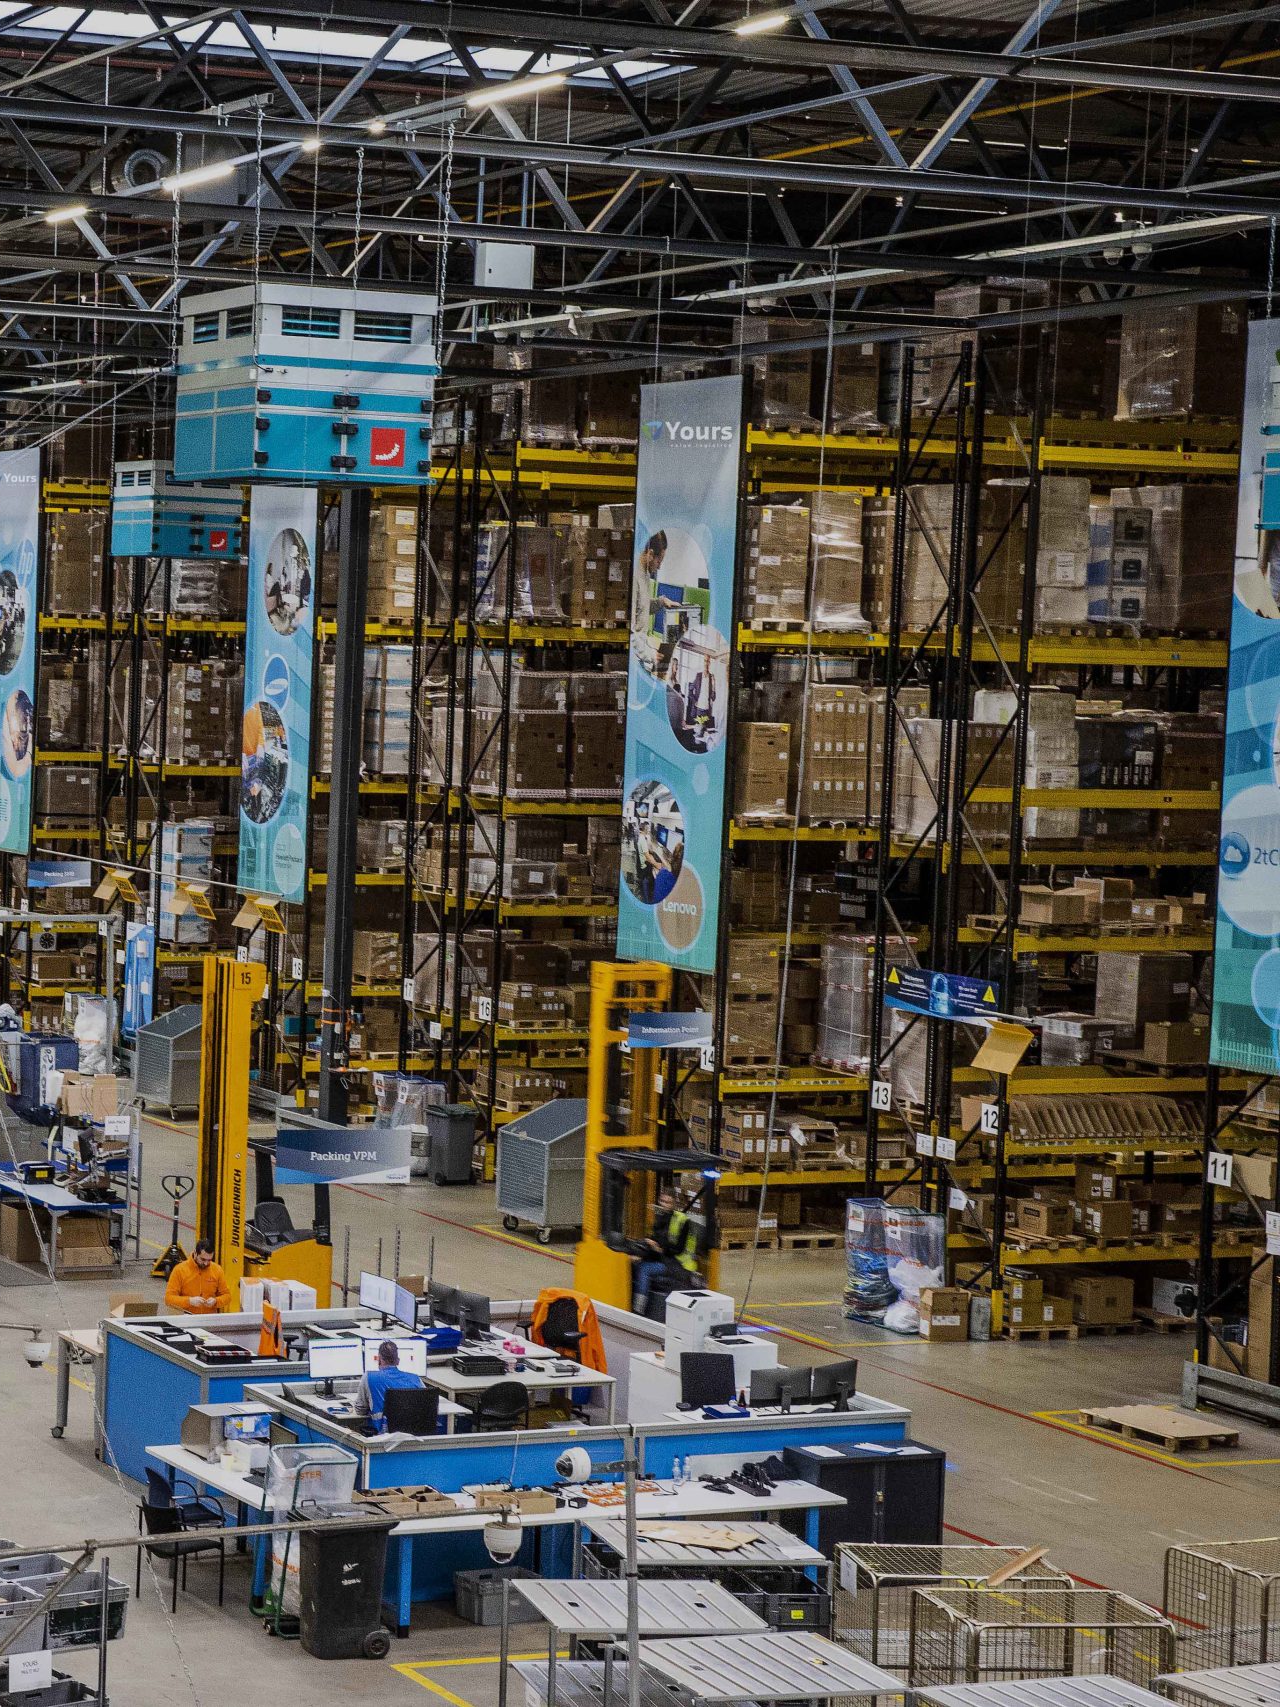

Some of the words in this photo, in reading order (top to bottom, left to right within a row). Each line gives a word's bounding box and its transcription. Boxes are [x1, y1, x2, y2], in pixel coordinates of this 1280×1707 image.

[665, 421, 733, 440] Yours
[3, 472, 37, 483] Yours
[1253, 847, 1280, 866] 2tC
[662, 899, 697, 916] Lenovo
[241, 972, 252, 985] 15
[480, 1000, 490, 1017] 16
[641, 1026, 681, 1034] Information
[681, 1026, 699, 1034] Point
[702, 1049, 715, 1067] 14
[874, 1085, 889, 1106] 13
[983, 1109, 999, 1130] 12
[310, 1151, 351, 1163] Packing
[352, 1151, 377, 1161] VPM
[1210, 1157, 1228, 1181] 11
[231, 1168, 243, 1248] JUNGHEINRICH
